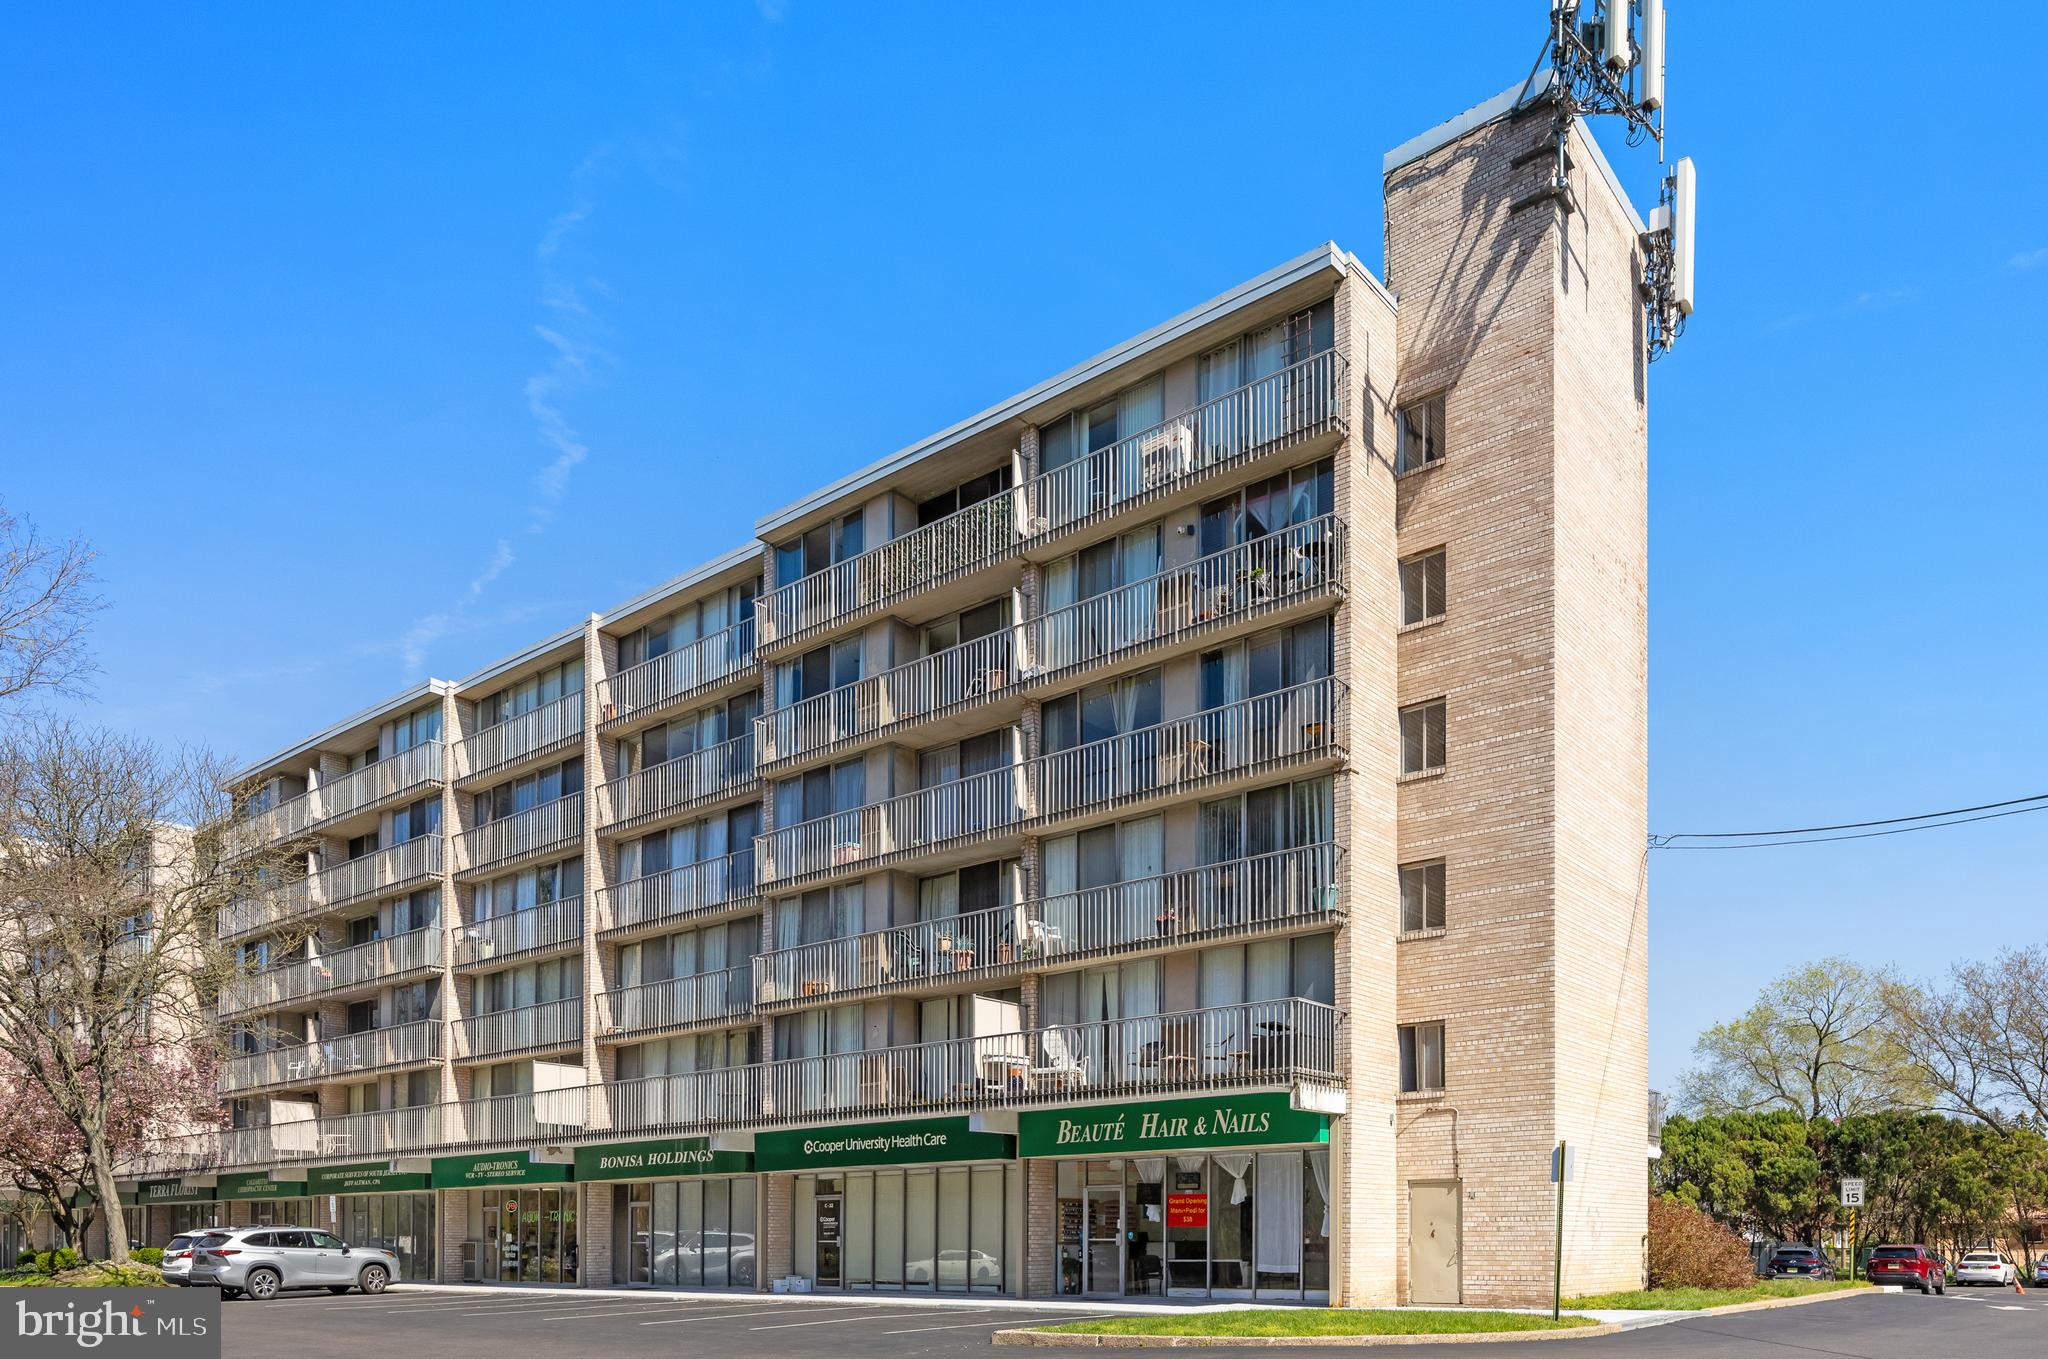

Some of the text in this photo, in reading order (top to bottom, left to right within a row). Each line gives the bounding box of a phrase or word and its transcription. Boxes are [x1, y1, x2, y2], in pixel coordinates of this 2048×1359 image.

[1139, 1112, 1188, 1139] HAIR
[1193, 1115, 1207, 1136] &
[1212, 1108, 1270, 1135] NAILS
[813, 1132, 947, 1154] Cooper University Health Care
[472, 1160, 518, 1172] AUDIO-TRONICS
[600, 1149, 714, 1169] BONISA HOLDINGS
[149, 1183, 198, 1198] TERRA FLORIST
[1846, 1193, 1859, 1203] 15
